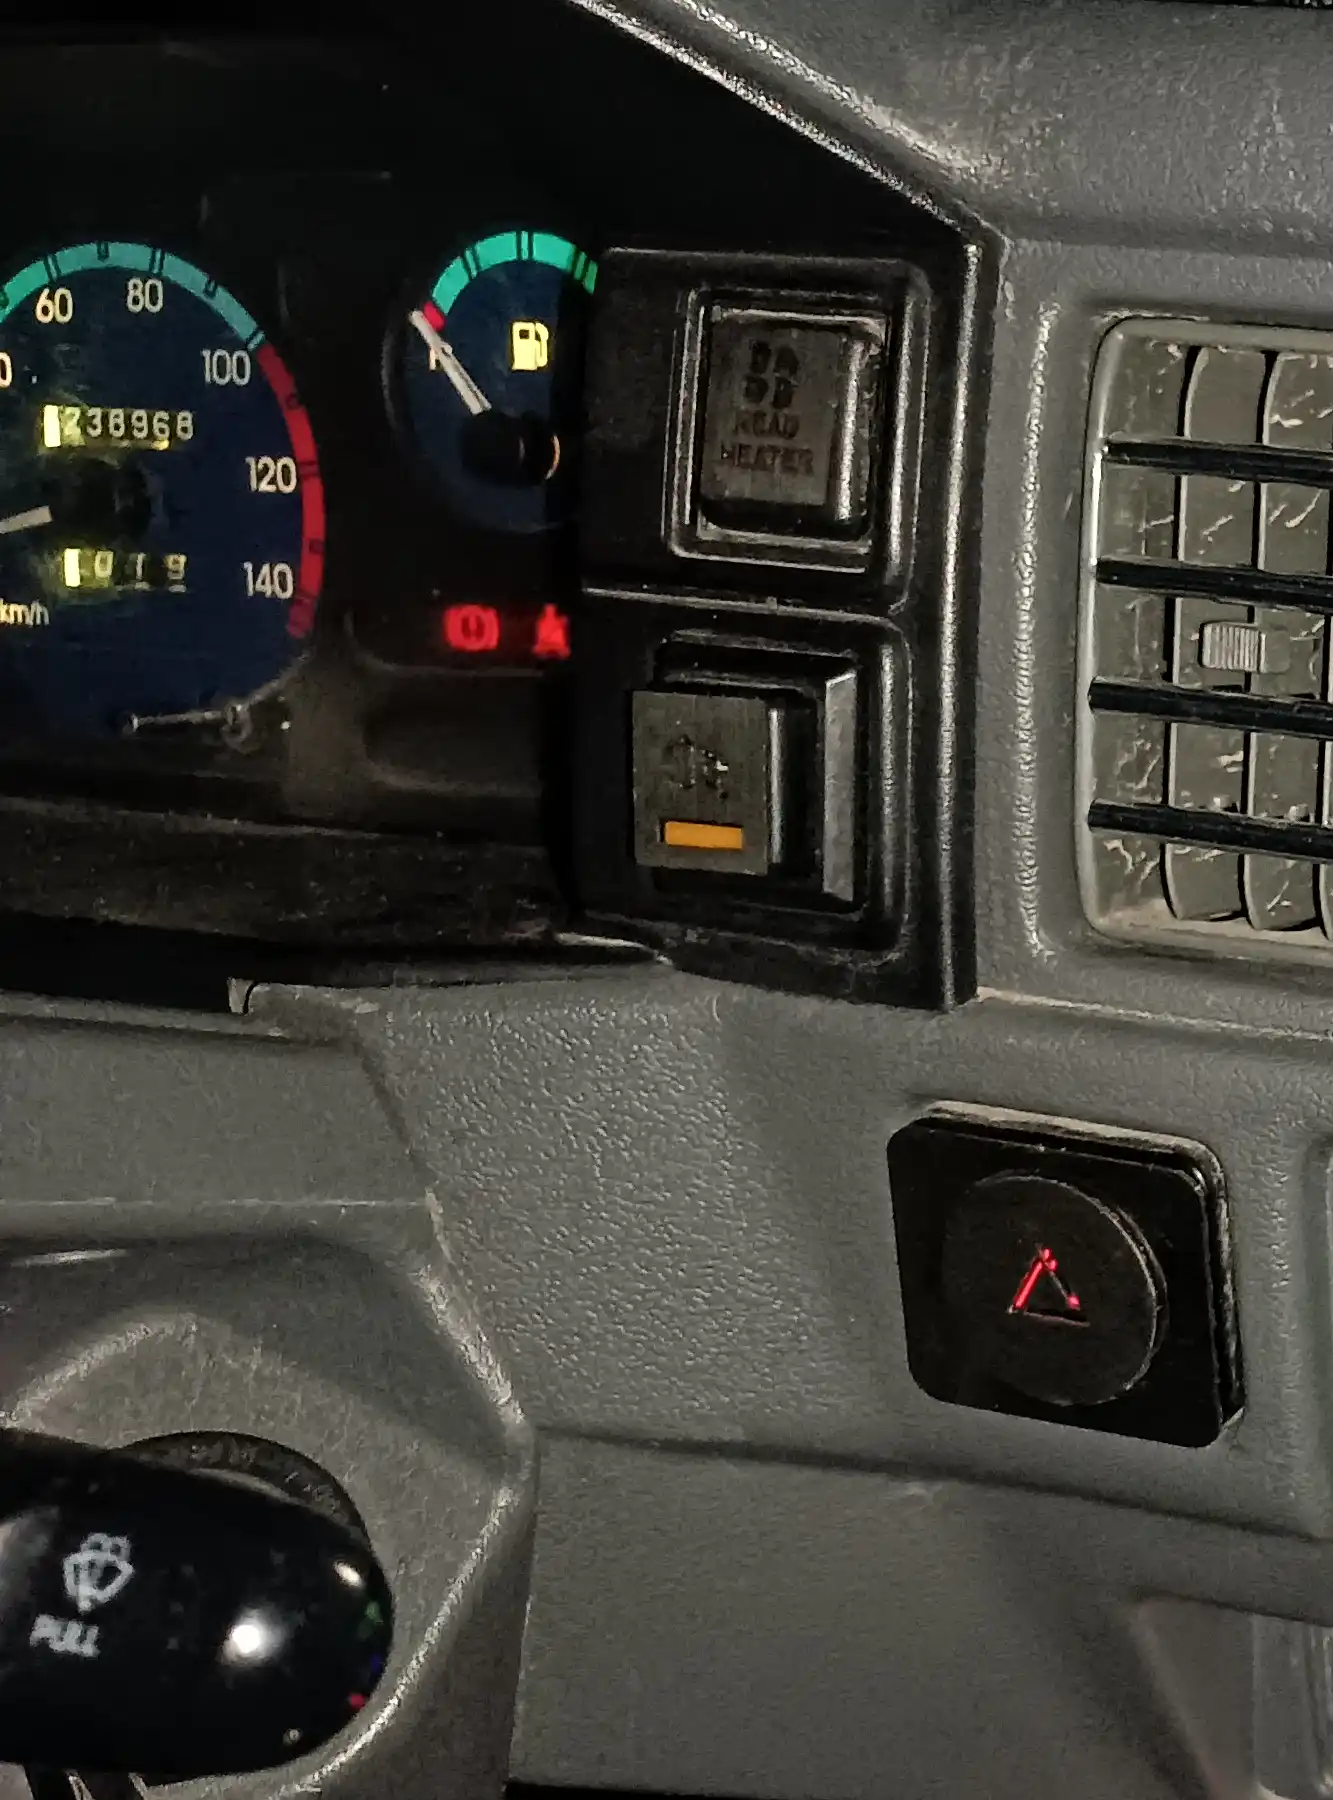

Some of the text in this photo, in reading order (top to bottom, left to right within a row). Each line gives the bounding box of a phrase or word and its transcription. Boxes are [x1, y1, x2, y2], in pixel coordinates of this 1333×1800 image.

[35, 287, 73, 323] 60
[126, 278, 164, 313] 80
[202, 349, 251, 386] 100
[245, 456, 297, 493] 120
[243, 561, 293, 599] 140
